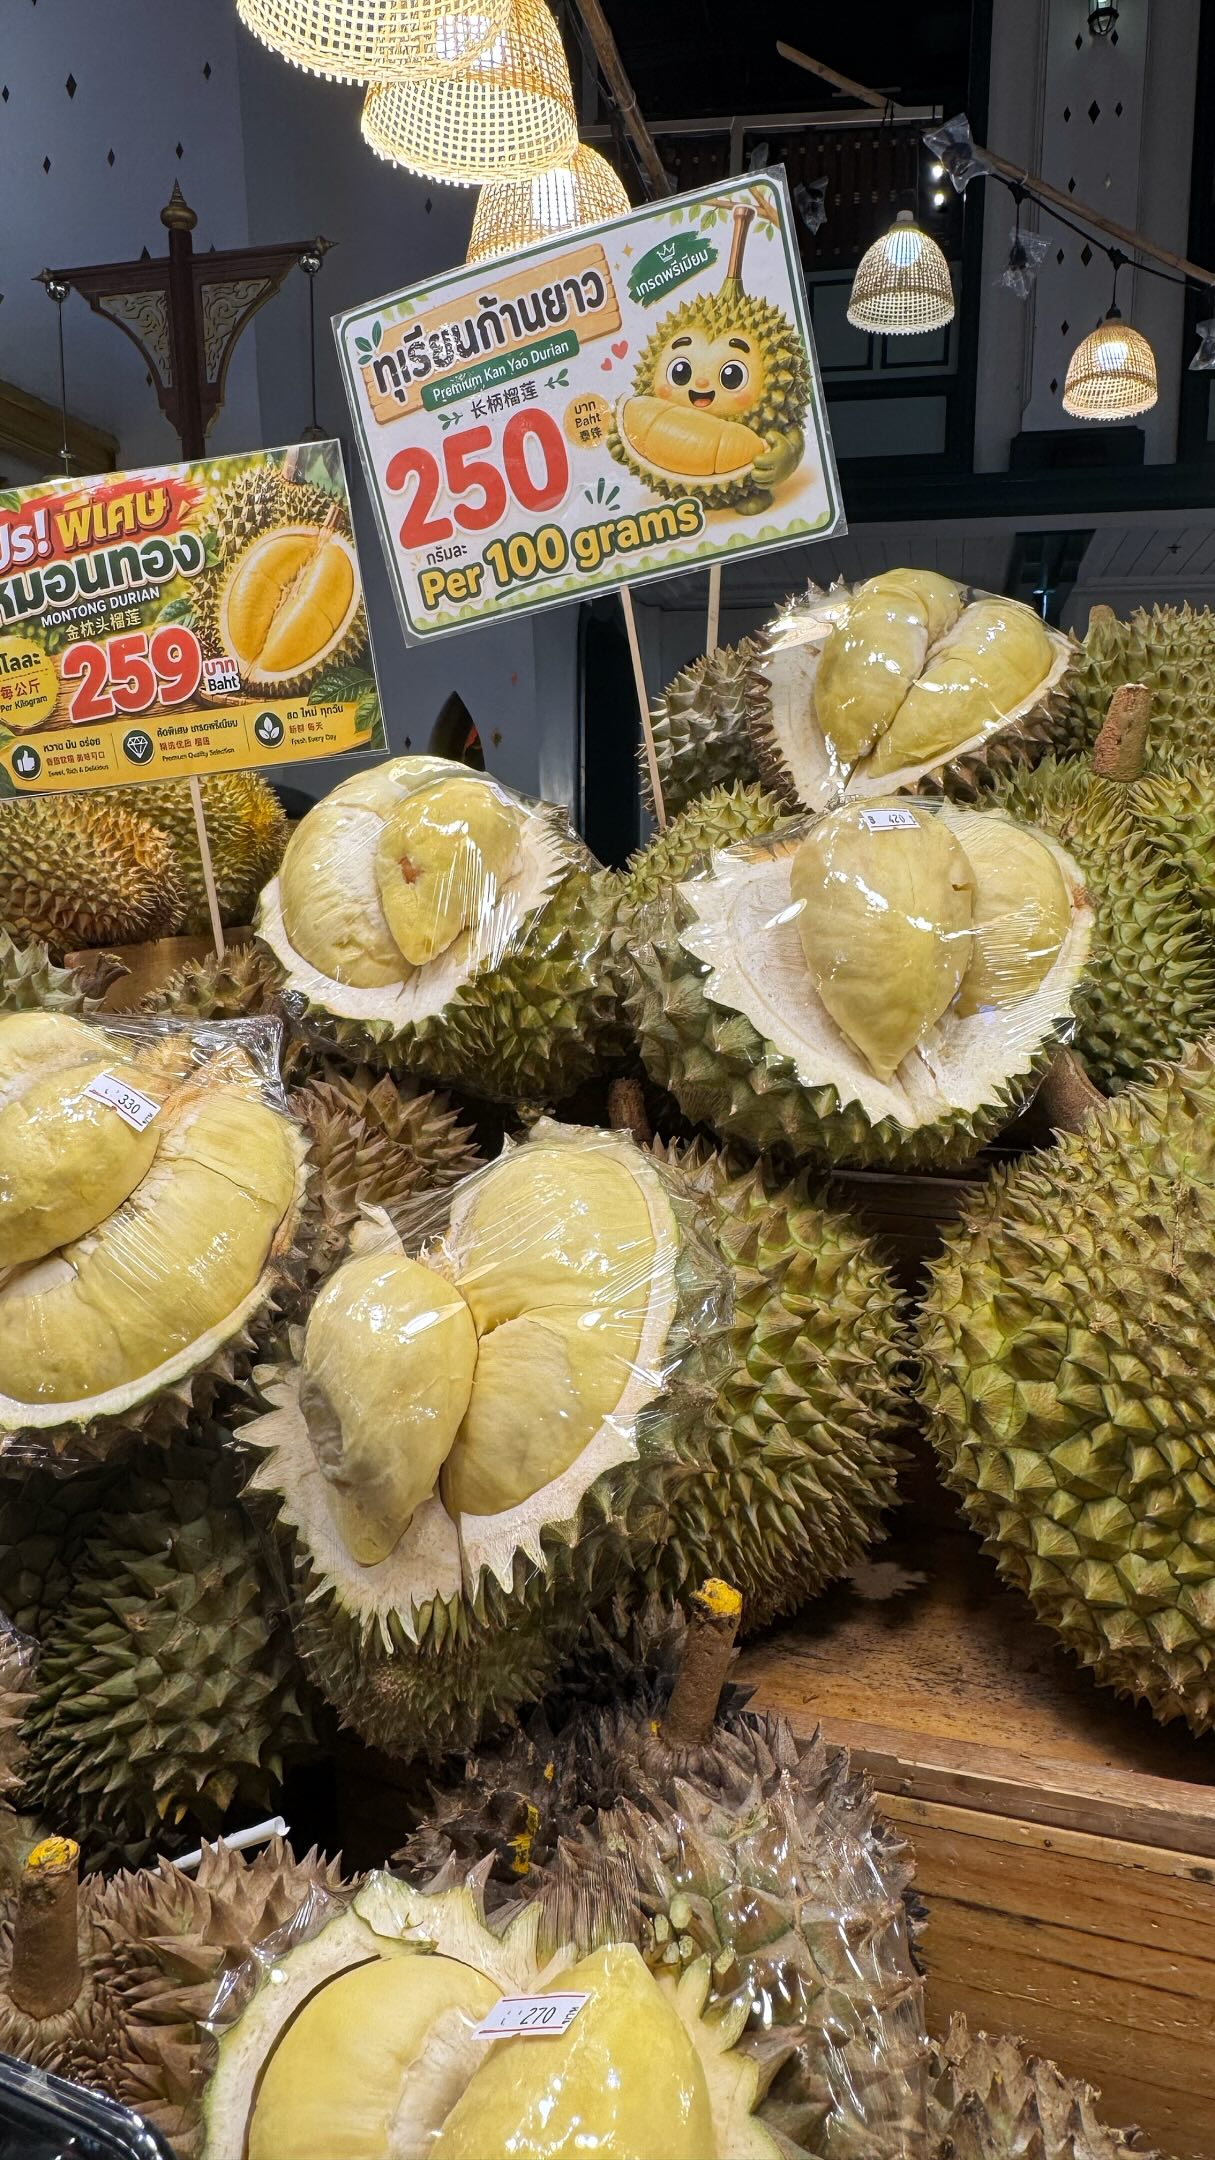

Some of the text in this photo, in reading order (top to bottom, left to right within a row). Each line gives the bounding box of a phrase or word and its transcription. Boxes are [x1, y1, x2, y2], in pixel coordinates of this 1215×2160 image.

[635, 249, 710, 297] เกรดพรีเมียม
[373, 271, 605, 403] ทุเรียนก้านยาว
[432, 342, 570, 402] Premium Kan Yao Durian
[471, 381, 539, 419] 长柄榴莲
[574, 400, 597, 415] บาท
[575, 412, 602, 429] Baht
[385, 408, 569, 550] 250
[421, 501, 699, 607] Per 100 grams
[427, 542, 468, 566] กรัมละ
[41, 586, 160, 628] MONTONG DURIAN
[65, 608, 142, 641] 金枕头榴莲
[0, 652, 41, 675] โลละ
[63, 627, 200, 721] 259
[204, 659, 236, 676] บาท
[208, 675, 238, 692] Baht
[15, 695, 48, 709] Kilogram
[117, 1094, 141, 1115] 330
[519, 2006, 557, 2026] 270
